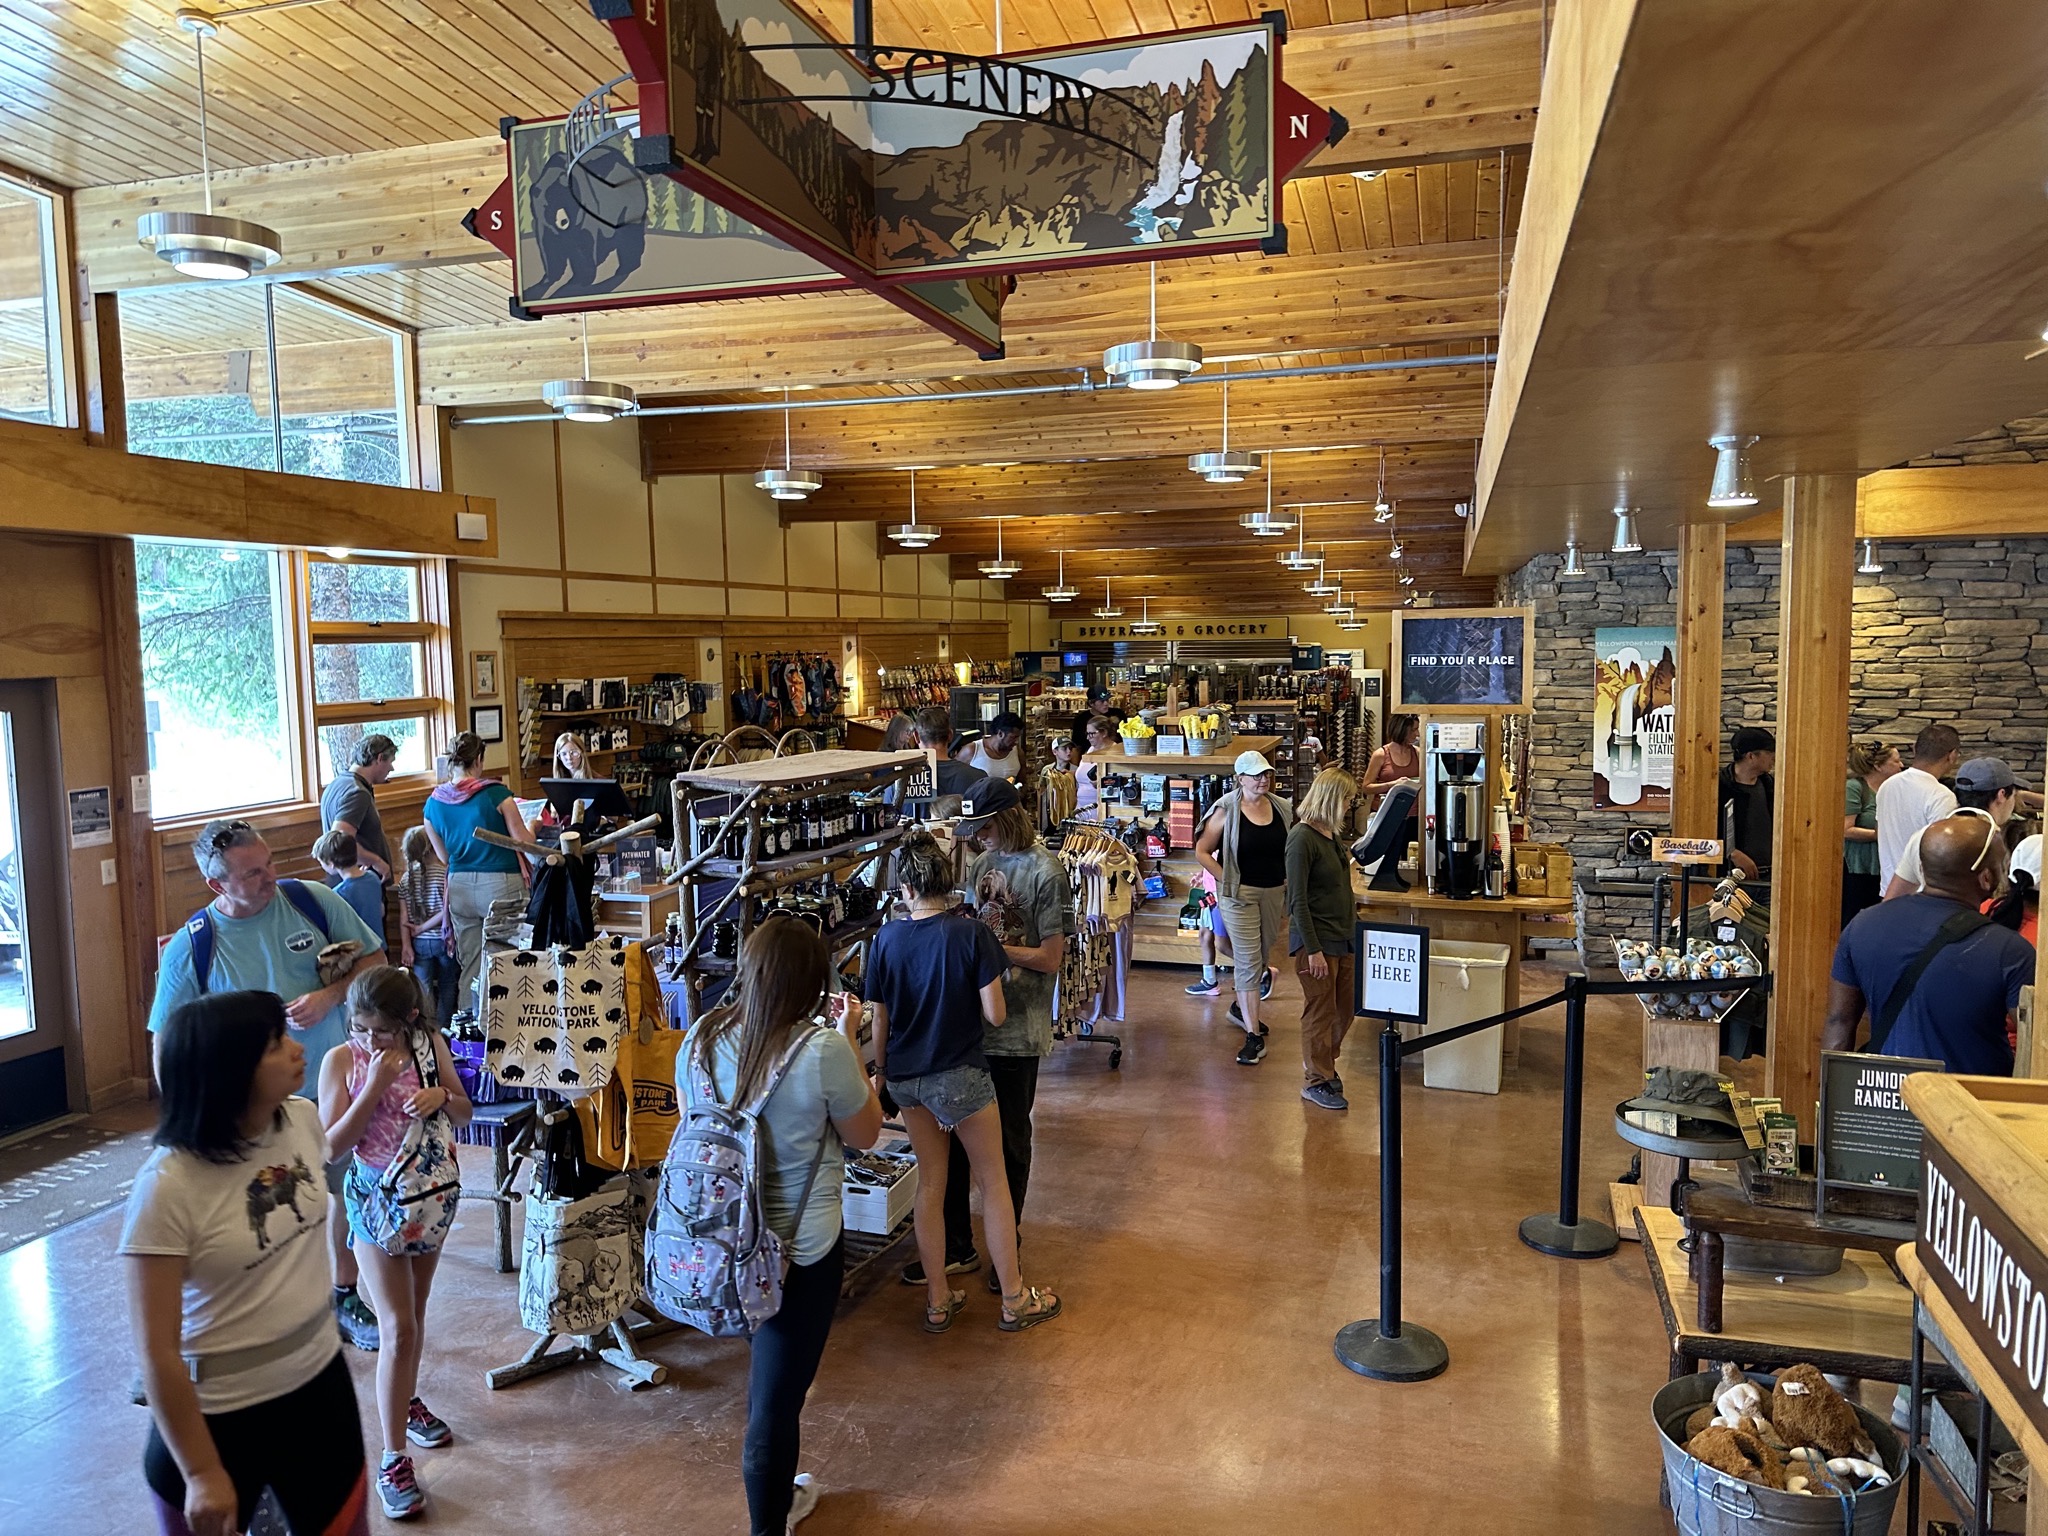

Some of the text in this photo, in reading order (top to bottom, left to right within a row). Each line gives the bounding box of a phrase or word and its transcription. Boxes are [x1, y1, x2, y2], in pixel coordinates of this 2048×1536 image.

[868, 50, 1099, 133] SCENERY
[1289, 114, 1310, 139] N
[490, 210, 502, 231] S
[1080, 624, 1268, 637] BEVERAS & GROCERY
[1411, 657, 1437, 665] FIND
[1479, 656, 1515, 665] PLACE
[1643, 714, 1675, 732] WAT
[1649, 733, 1674, 743] FILLIN
[1660, 839, 1713, 851] Baseballs
[1368, 943, 1416, 963] ENTER
[1372, 963, 1411, 983] HERE
[567, 1016, 600, 1030] PARK
[641, 1099, 667, 1108] PARK
[1925, 1159, 2048, 1408] YELLOWSTO
